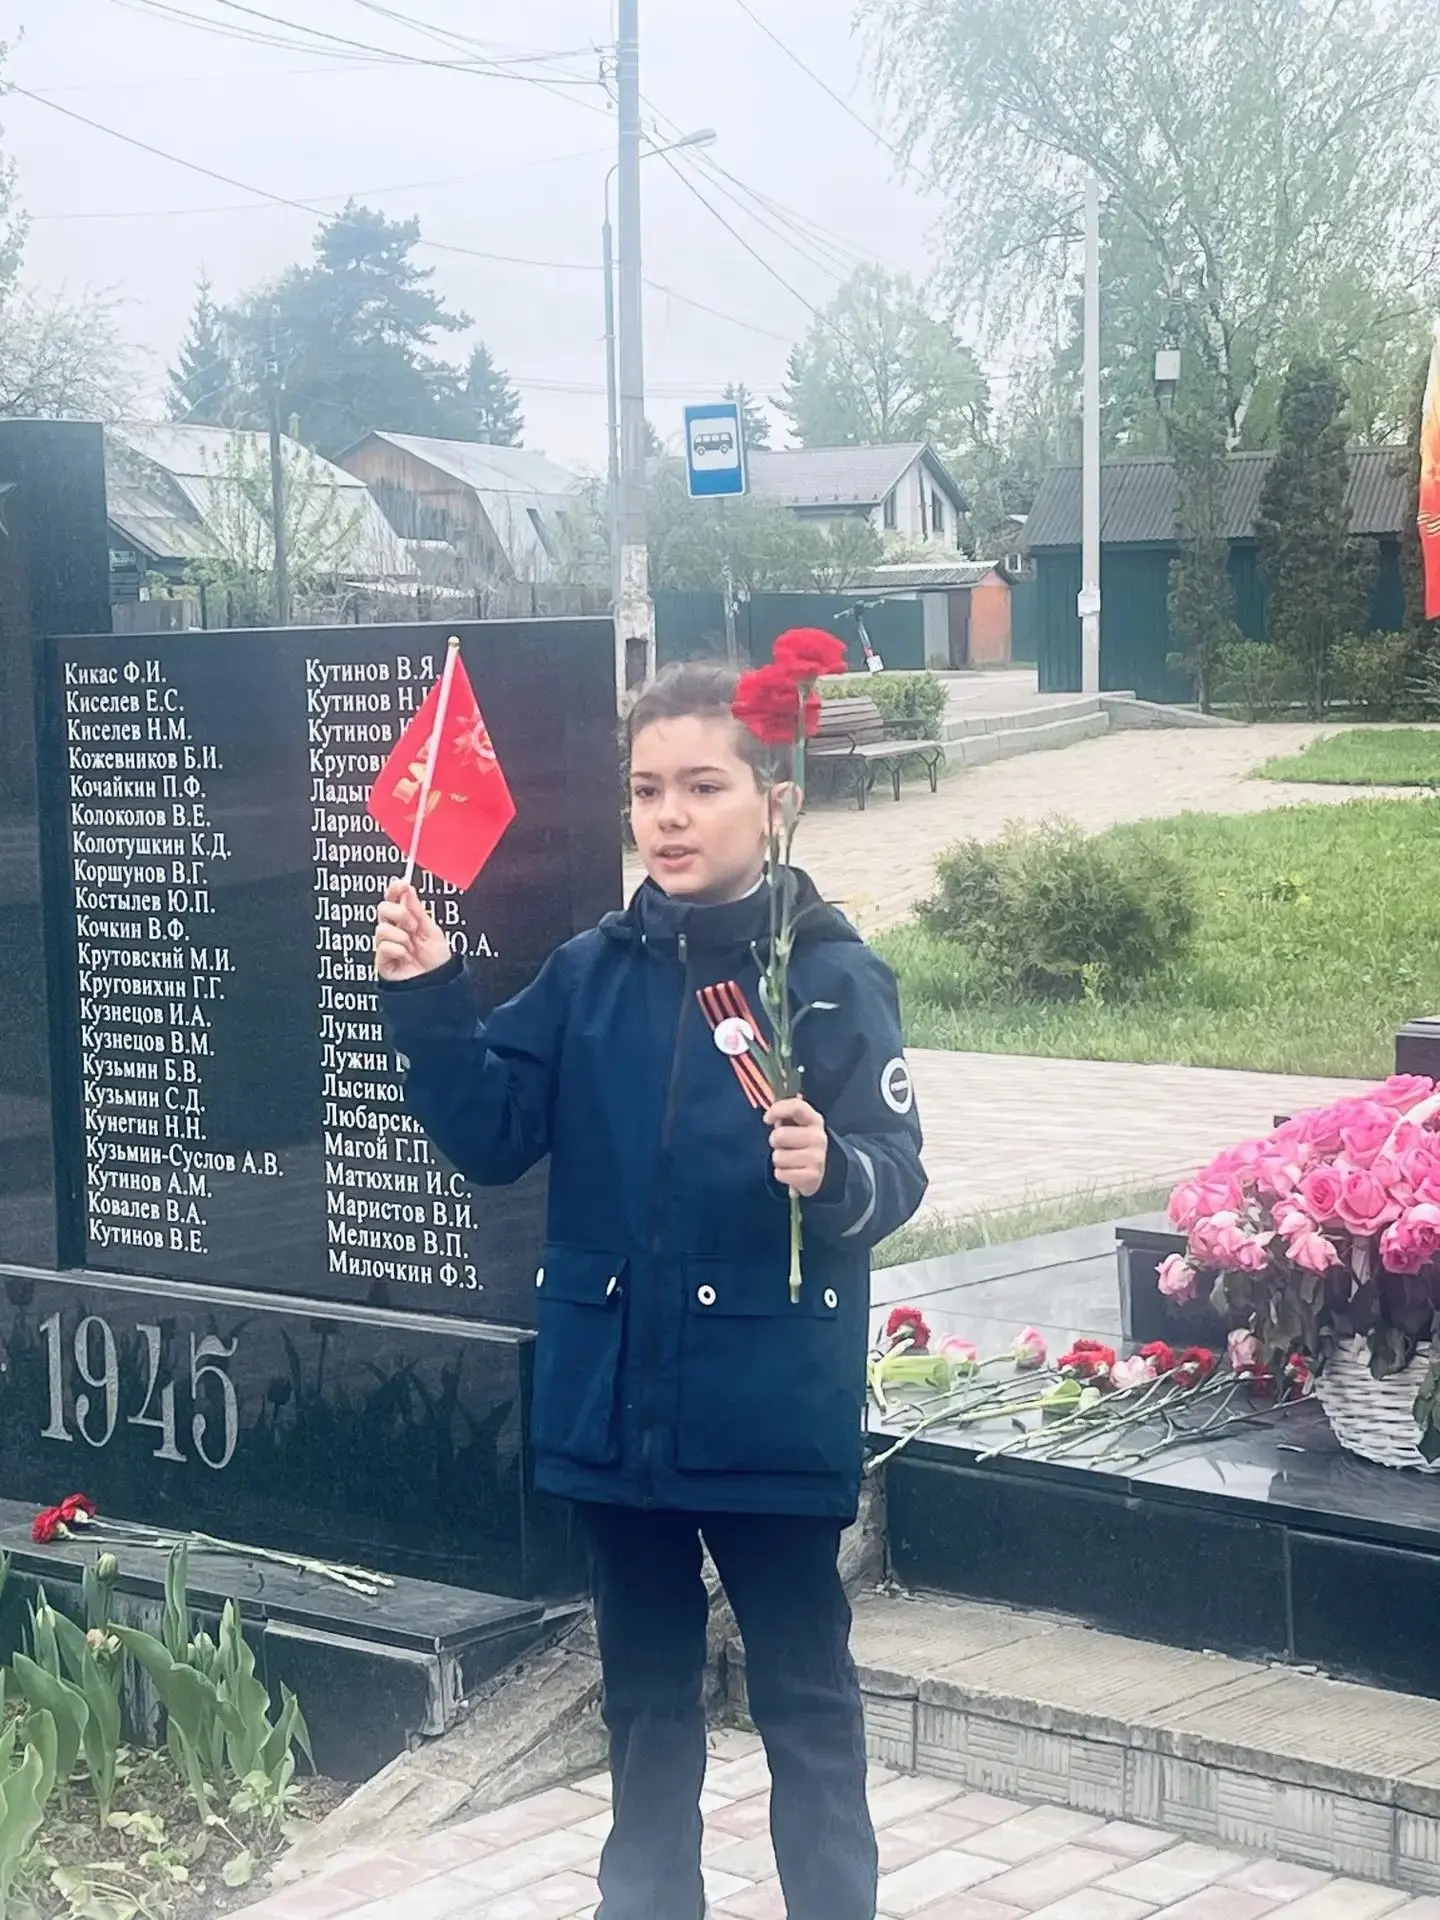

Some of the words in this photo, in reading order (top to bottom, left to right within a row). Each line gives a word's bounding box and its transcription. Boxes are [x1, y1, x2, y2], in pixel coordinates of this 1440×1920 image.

[65, 663, 117, 684] Кикас
[123, 660, 167, 683] Ф.И.
[306, 658, 390, 688] Кутинов
[397, 655, 441, 681] В.Я.
[66, 691, 140, 712] Киселев
[146, 688, 184, 712] Е.С.
[307, 688, 391, 718] Кутинов
[67, 718, 141, 741] Киселев
[147, 717, 192, 741] Н.М.
[308, 719, 392, 748] Кутинов
[69, 746, 178, 770] Кожевников
[184, 745, 223, 769] Б.И.
[70, 774, 156, 797] Кочайкин
[163, 774, 206, 798] П.Ф.
[72, 802, 166, 826] Колоколов
[172, 803, 211, 827] В.Е.
[73, 830, 185, 860] Колотушкин
[191, 832, 231, 860] К.Д.
[74, 858, 166, 888] Коршунов
[172, 860, 207, 884] В.Г.
[75, 886, 162, 911] Костылев
[168, 889, 215, 913] Ю.П.
[77, 914, 142, 939] Кочкин
[148, 916, 189, 941] В.Ф.
[78, 942, 185, 971] Крутовский
[190, 947, 235, 971] М.И.
[79, 970, 186, 1000] Круговихин
[193, 975, 225, 999] Г.Г.
[80, 998, 163, 1026] Кузнецов
[170, 1002, 211, 1027] И.А.
[81, 1025, 165, 1053] Кузнецов
[171, 1030, 214, 1056] В.М.
[319, 1015, 383, 1045] Лукин
[82, 1053, 158, 1081] Кузьмин
[165, 1058, 202, 1083] Б.В.
[320, 1044, 388, 1074] Лужин
[83, 1080, 159, 1108] Кузьмин
[165, 1086, 205, 1116] С.Д.
[84, 1107, 159, 1136] Кунегин
[165, 1114, 206, 1140] Н.Н.
[86, 1135, 235, 1172] Кузьмин-Суслов
[242, 1151, 283, 1176] А.В.
[324, 1131, 388, 1161] Магой
[395, 1138, 435, 1164] Г.П.
[87, 1163, 162, 1192] Кутинов
[168, 1172, 212, 1198] А.М.
[325, 1160, 418, 1193] Матюхин
[426, 1170, 471, 1198] И.С.
[88, 1190, 160, 1220] Ковалев
[166, 1199, 206, 1225] В.А.
[326, 1190, 425, 1223] Маристов
[432, 1202, 478, 1229] В.И.
[89, 1218, 163, 1248] Кутинов
[170, 1228, 208, 1253] В.Е.
[327, 1219, 416, 1251] Мелихов
[423, 1230, 468, 1258] В.П.
[328, 1249, 432, 1284] Милочкин
[439, 1262, 484, 1290] Ф.З.
[39, 1311, 239, 1469] 1945
